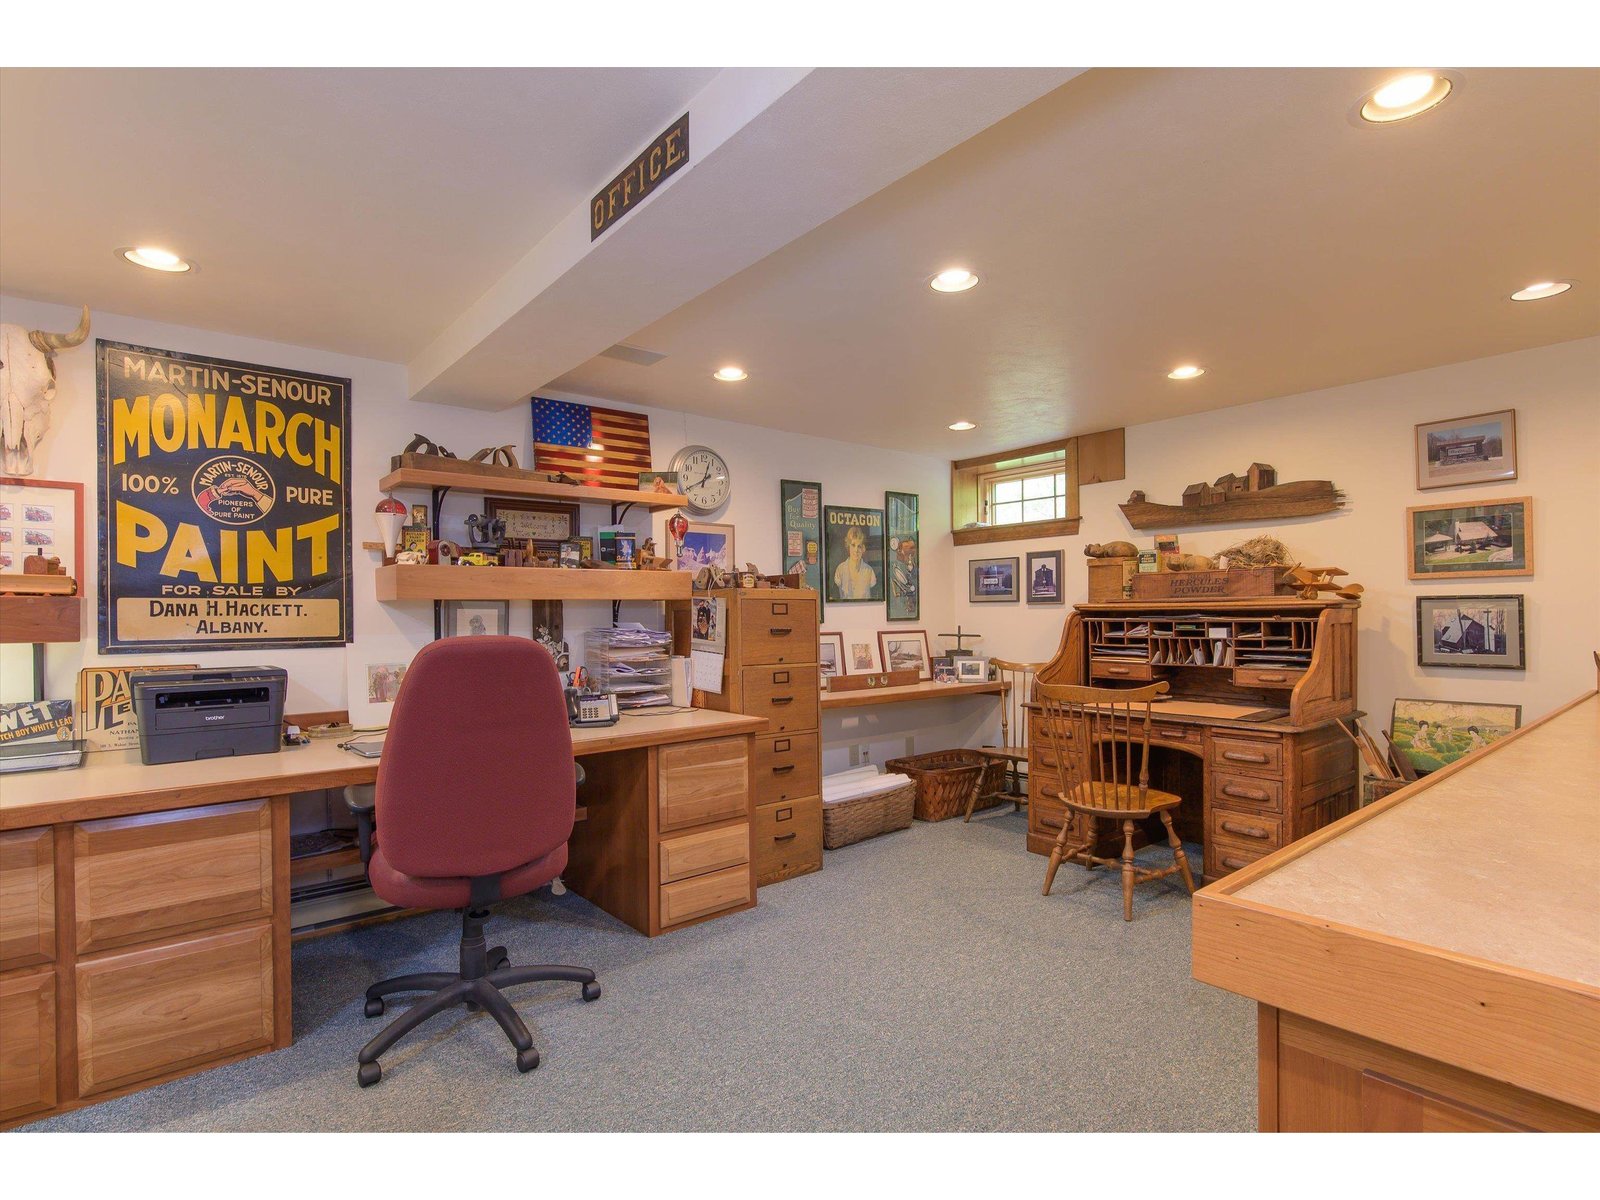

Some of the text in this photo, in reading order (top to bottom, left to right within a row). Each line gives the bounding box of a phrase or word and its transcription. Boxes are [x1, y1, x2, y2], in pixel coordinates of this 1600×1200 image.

[594, 128, 686, 229] OFFICE.
[123, 356, 332, 406] MARTIN-SENOUR
[113, 393, 341, 485] MONARCH
[121, 473, 180, 496] 100%
[199, 460, 269, 491] MARTIN-SENOUR
[218, 499, 254, 508] PIONEERS
[286, 486, 334, 506] PURE
[214, 511, 255, 520] PURE PAINT
[790, 520, 816, 529] Quality
[829, 511, 881, 527] OCTAGON
[116, 500, 340, 584] PAINT
[161, 584, 302, 597] FOR SALE BY
[1170, 577, 1229, 588] HERCULES
[1174, 585, 1225, 595] POWDER
[149, 600, 308, 618] DANA H. HACKETT.
[195, 619, 268, 635] ALBANY.
[86, 670, 131, 732] PA
[104, 701, 131, 731] LE
[15, 727, 30, 738] BOY
[31, 721, 55, 733] WHITE
[55, 716, 73, 728] LEAD
